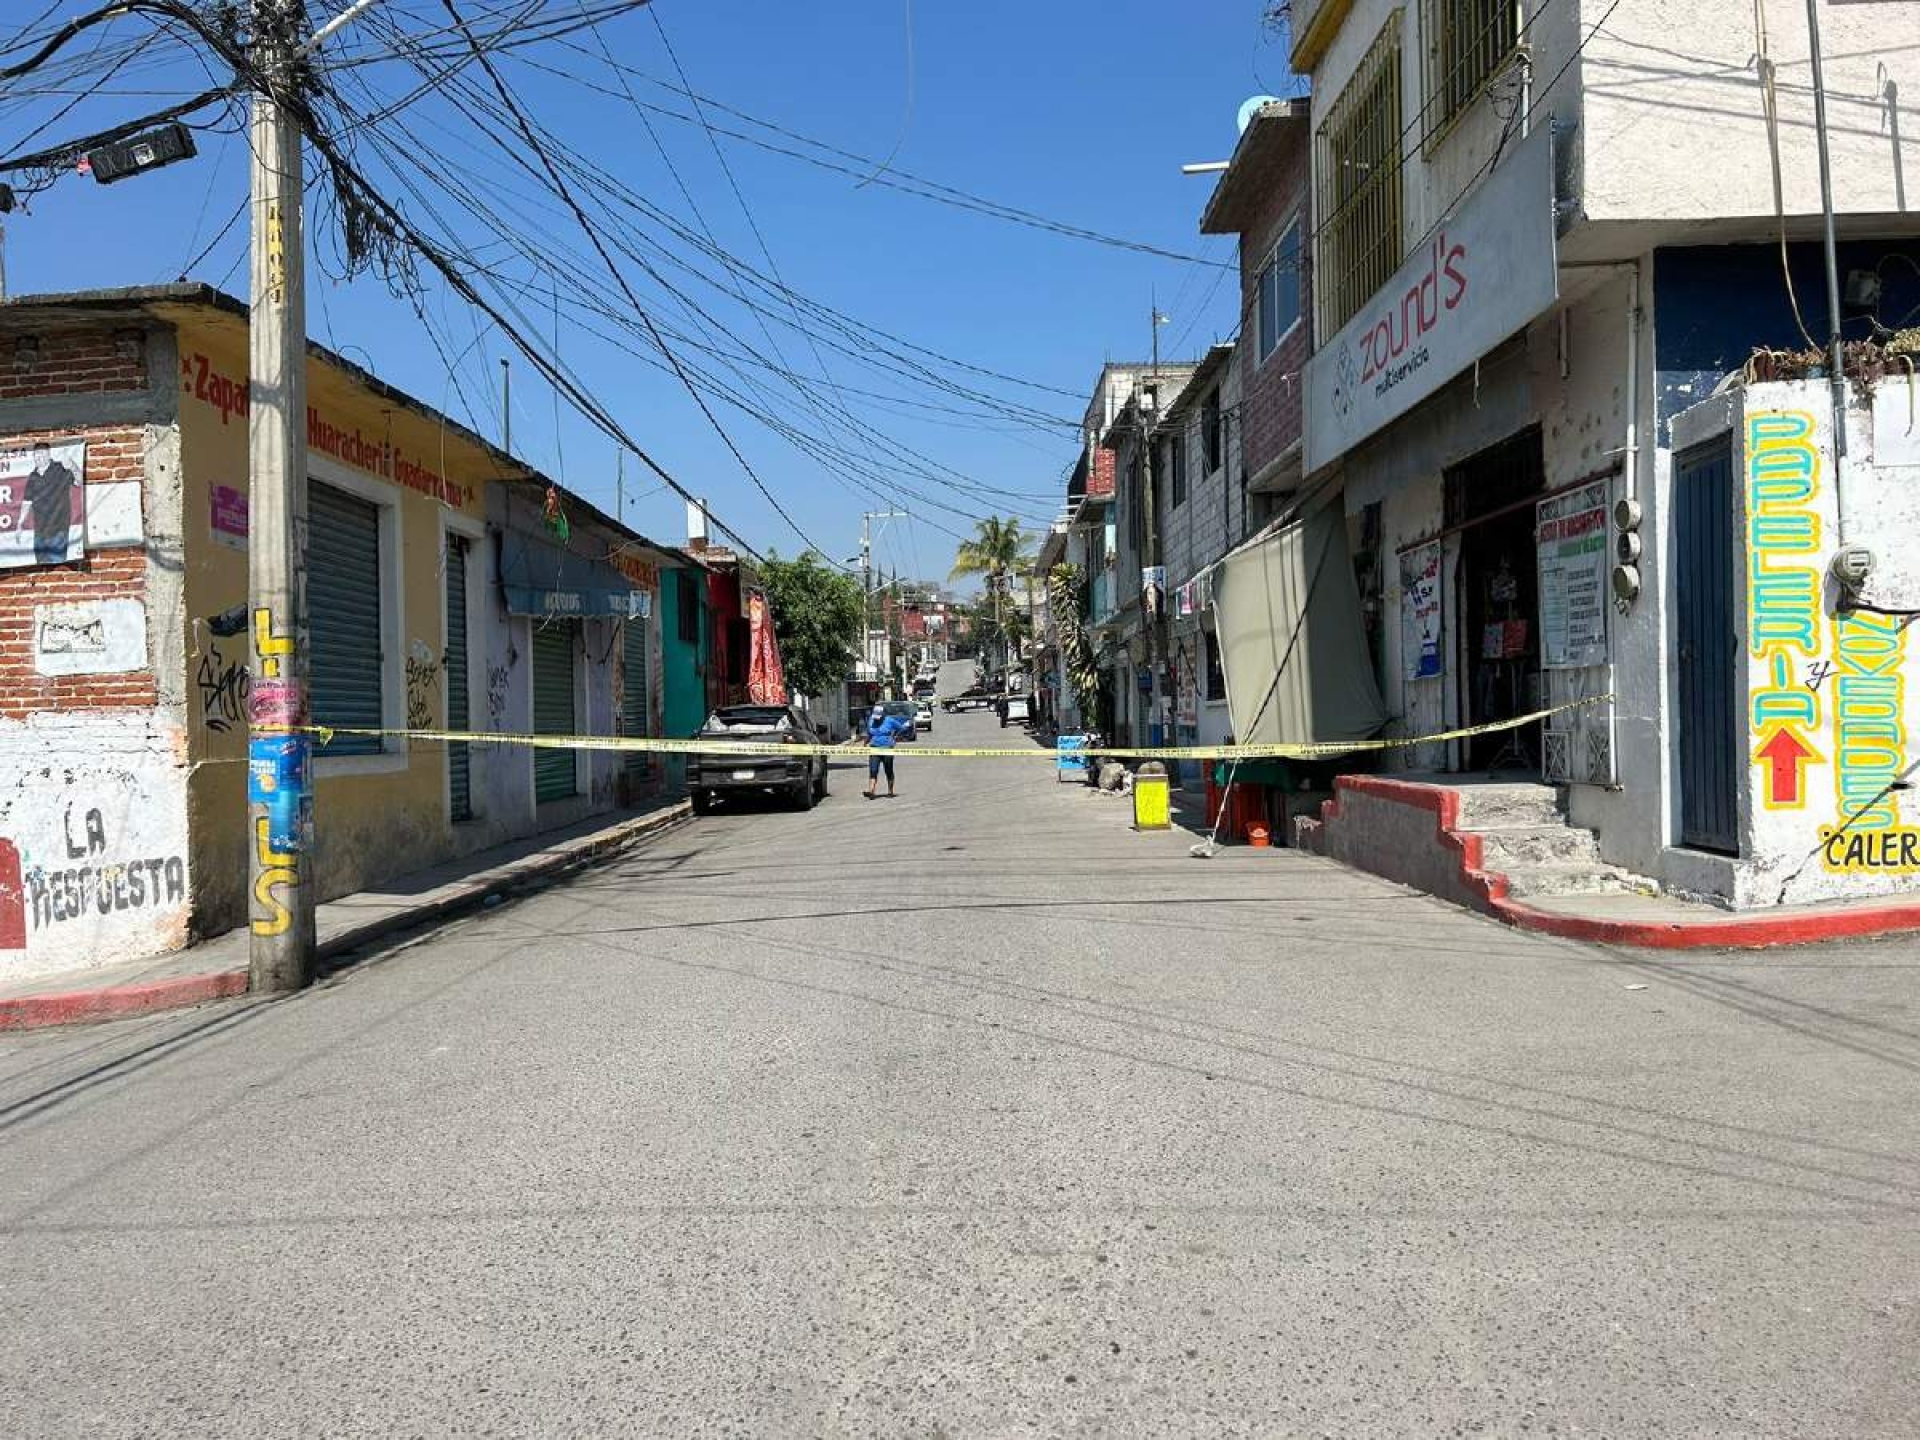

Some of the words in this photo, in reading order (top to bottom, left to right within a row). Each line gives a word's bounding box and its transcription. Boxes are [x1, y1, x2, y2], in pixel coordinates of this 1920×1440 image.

[1360, 231, 1467, 385] zound's
[1749, 415, 1816, 728] PAPELERIA
[64, 801, 107, 860] LA
[25, 855, 186, 932] RESPUESTA
